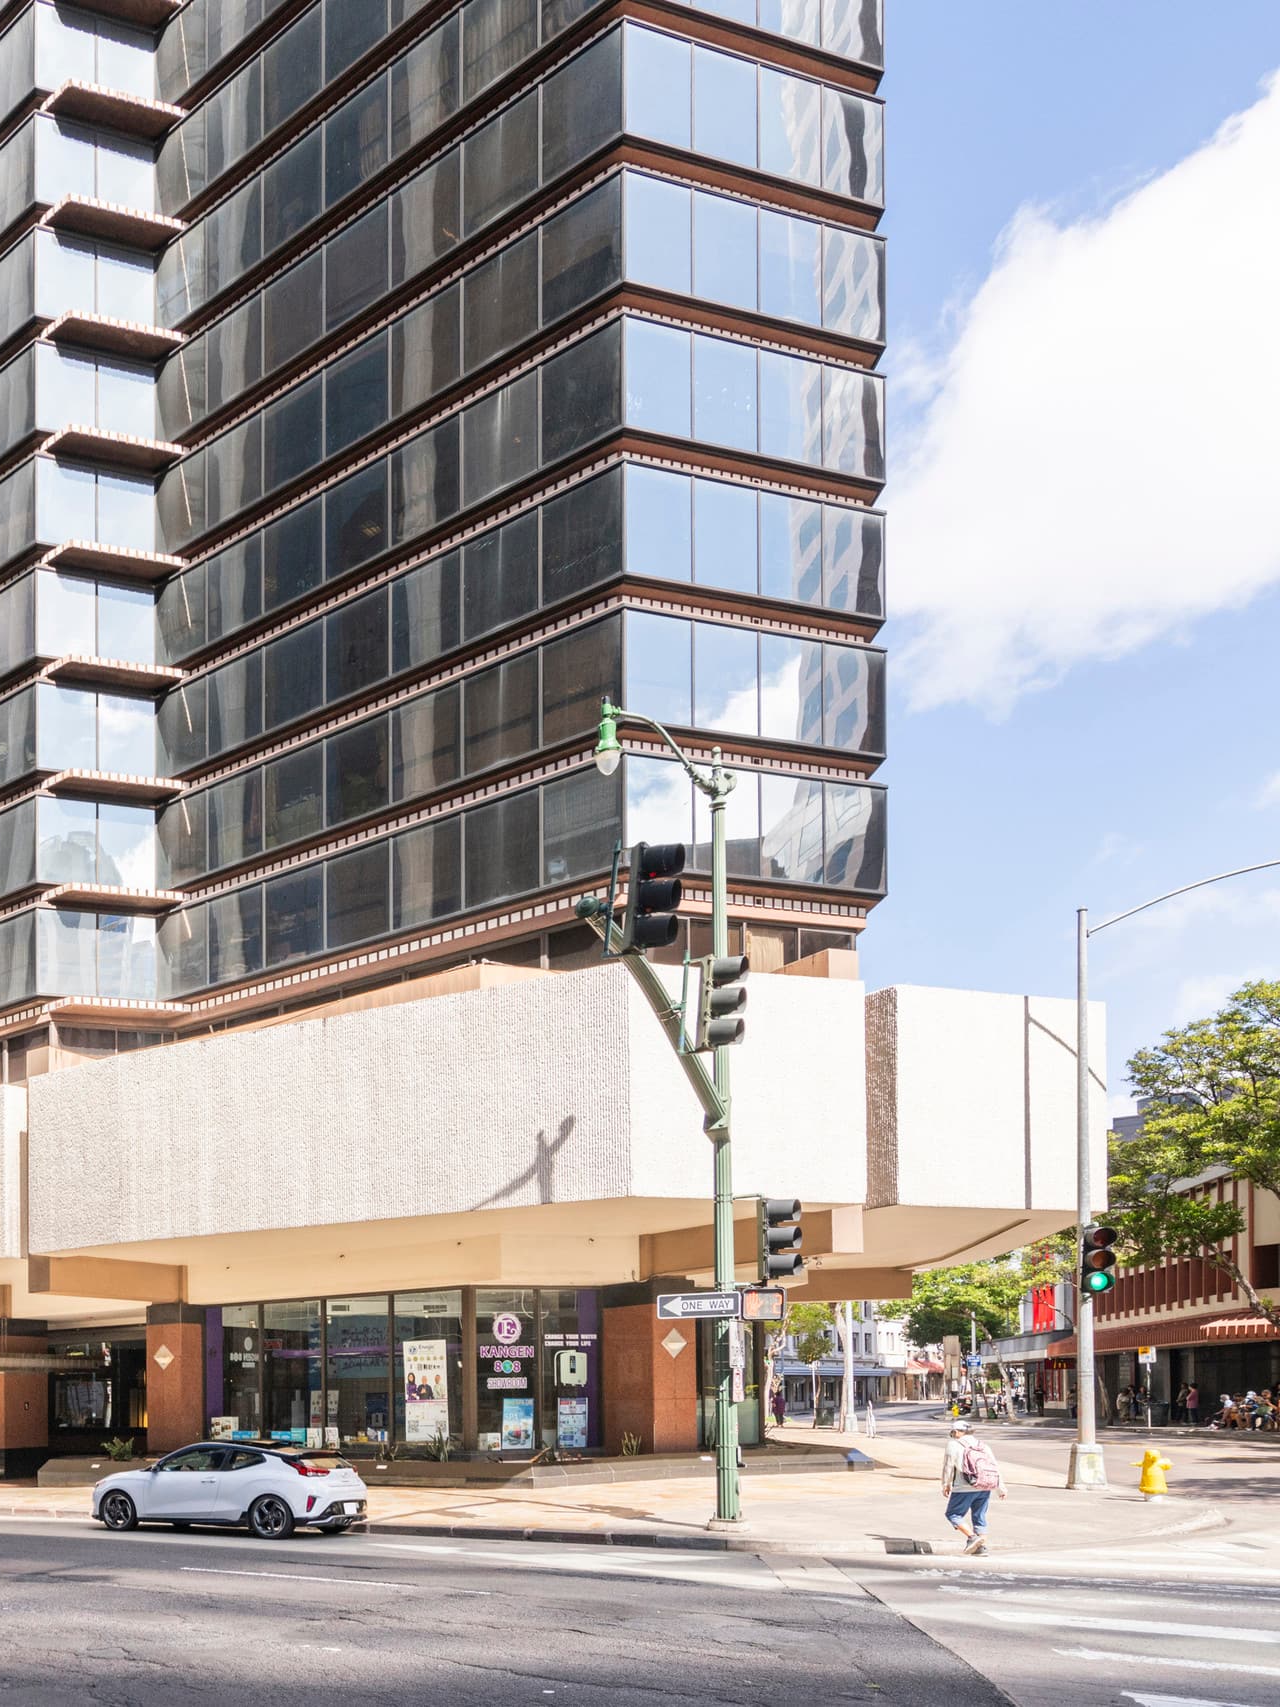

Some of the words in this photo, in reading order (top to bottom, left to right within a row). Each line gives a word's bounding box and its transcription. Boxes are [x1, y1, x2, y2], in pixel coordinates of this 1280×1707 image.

[681, 1301, 703, 1311] ONE
[709, 1300, 731, 1309] WAY
[480, 1345, 535, 1358] KANGEN
[486, 1377, 528, 1389] SHOWROOM
